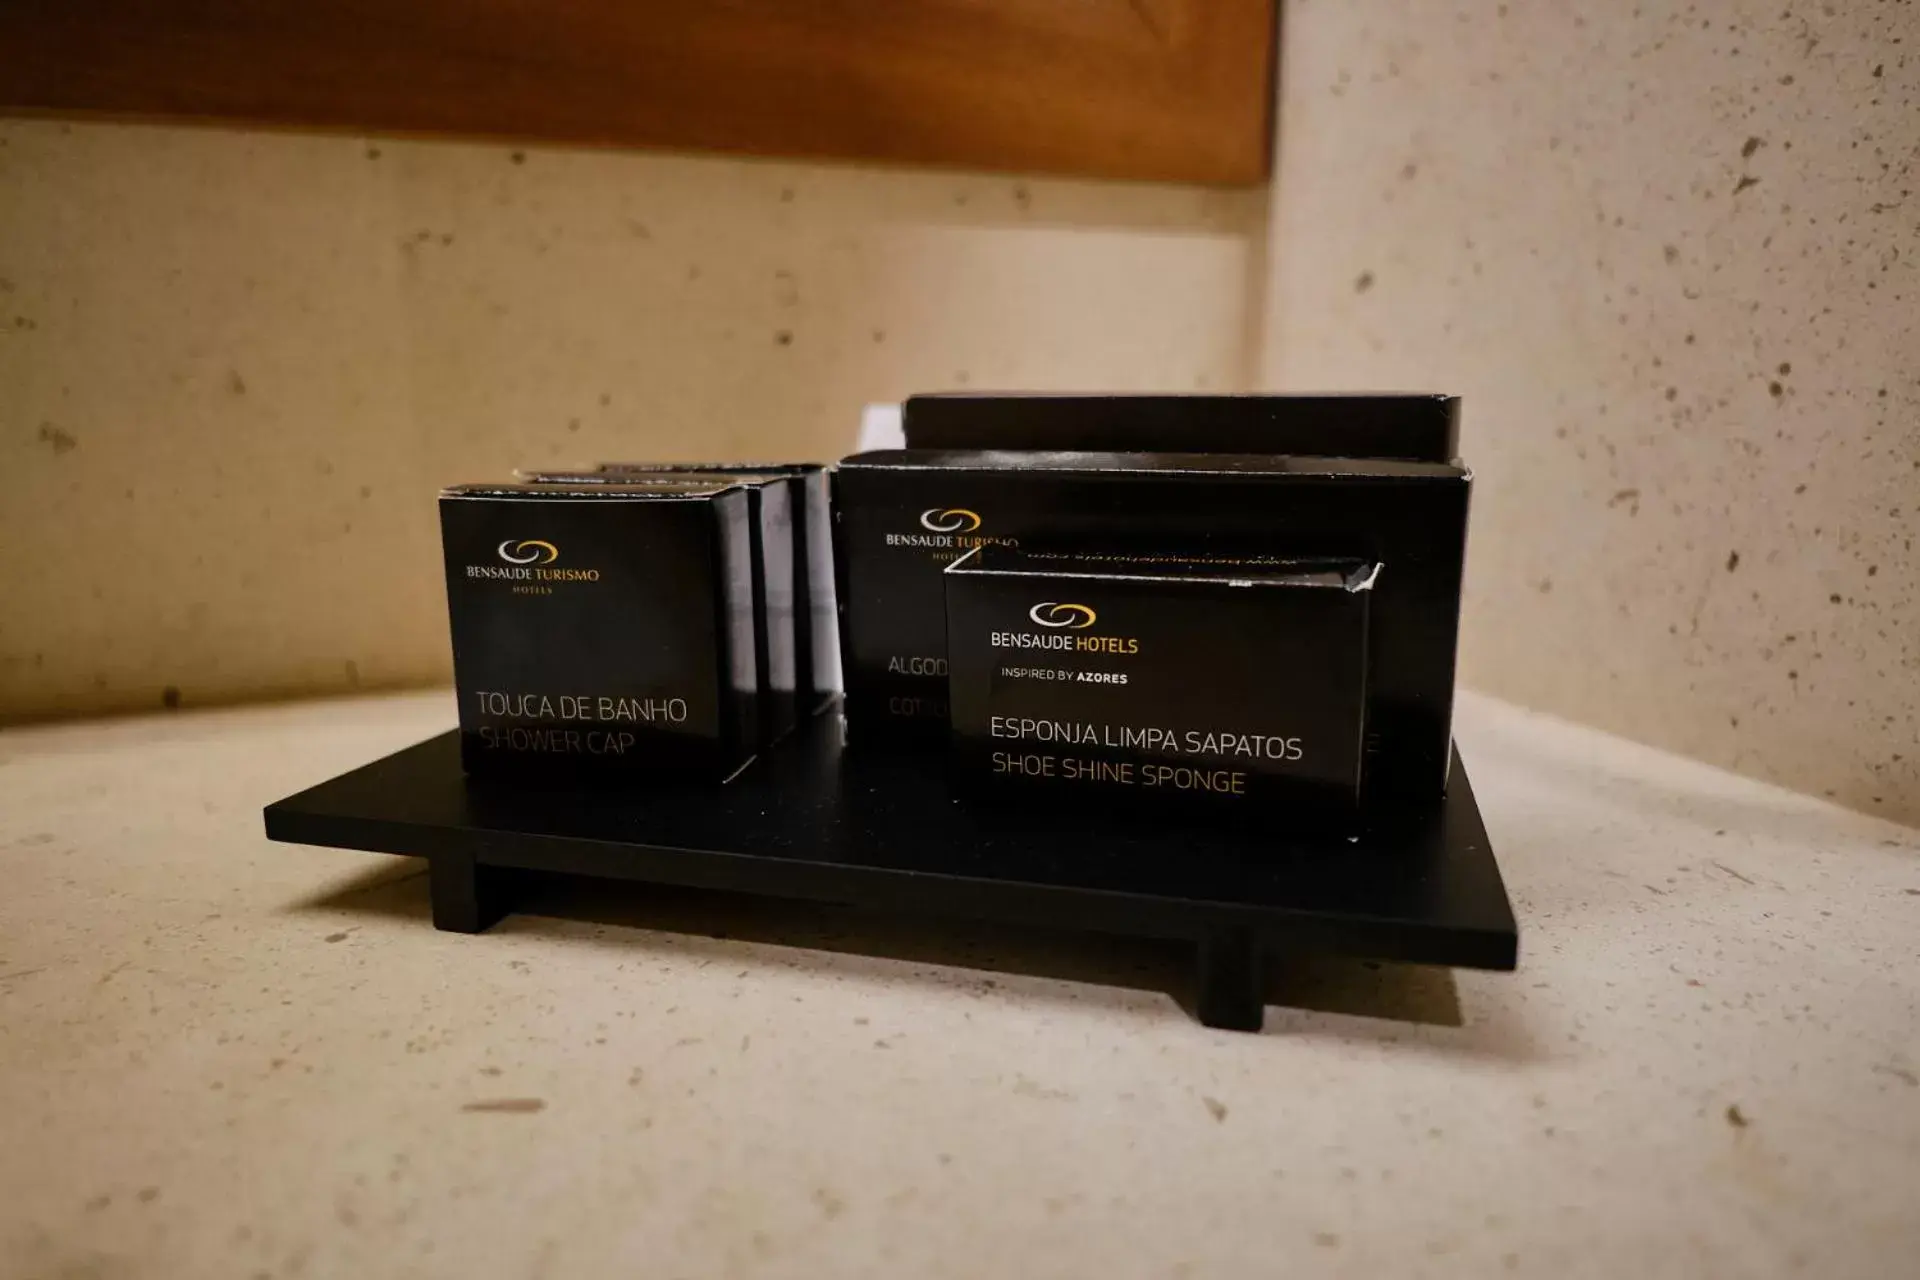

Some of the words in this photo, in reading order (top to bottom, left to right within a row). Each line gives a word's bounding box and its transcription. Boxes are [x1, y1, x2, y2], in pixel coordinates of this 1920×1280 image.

[885, 533, 953, 548] BENSAUDE
[466, 565, 532, 580] BENSAUDE
[535, 567, 600, 582] TURISMO
[512, 585, 553, 595] HOTELS
[991, 631, 1073, 650] BENSAUDE
[1076, 636, 1139, 654] HOTELS
[1001, 667, 1055, 680] INSPIRED
[1057, 670, 1075, 681] BY
[1076, 671, 1129, 685] AZORES
[475, 691, 555, 719] TOUCA
[559, 695, 593, 720] DE
[598, 697, 688, 722] BANHO
[479, 726, 582, 754] SHOWER
[586, 731, 637, 756] CAP
[991, 716, 1099, 745] ESPONJA
[1104, 725, 1179, 752] LIMPA
[1185, 730, 1304, 761] SAPATOS
[992, 752, 1056, 777] SHOE
[1061, 757, 1135, 785] SHINE
[1141, 764, 1248, 795] SPONGE
